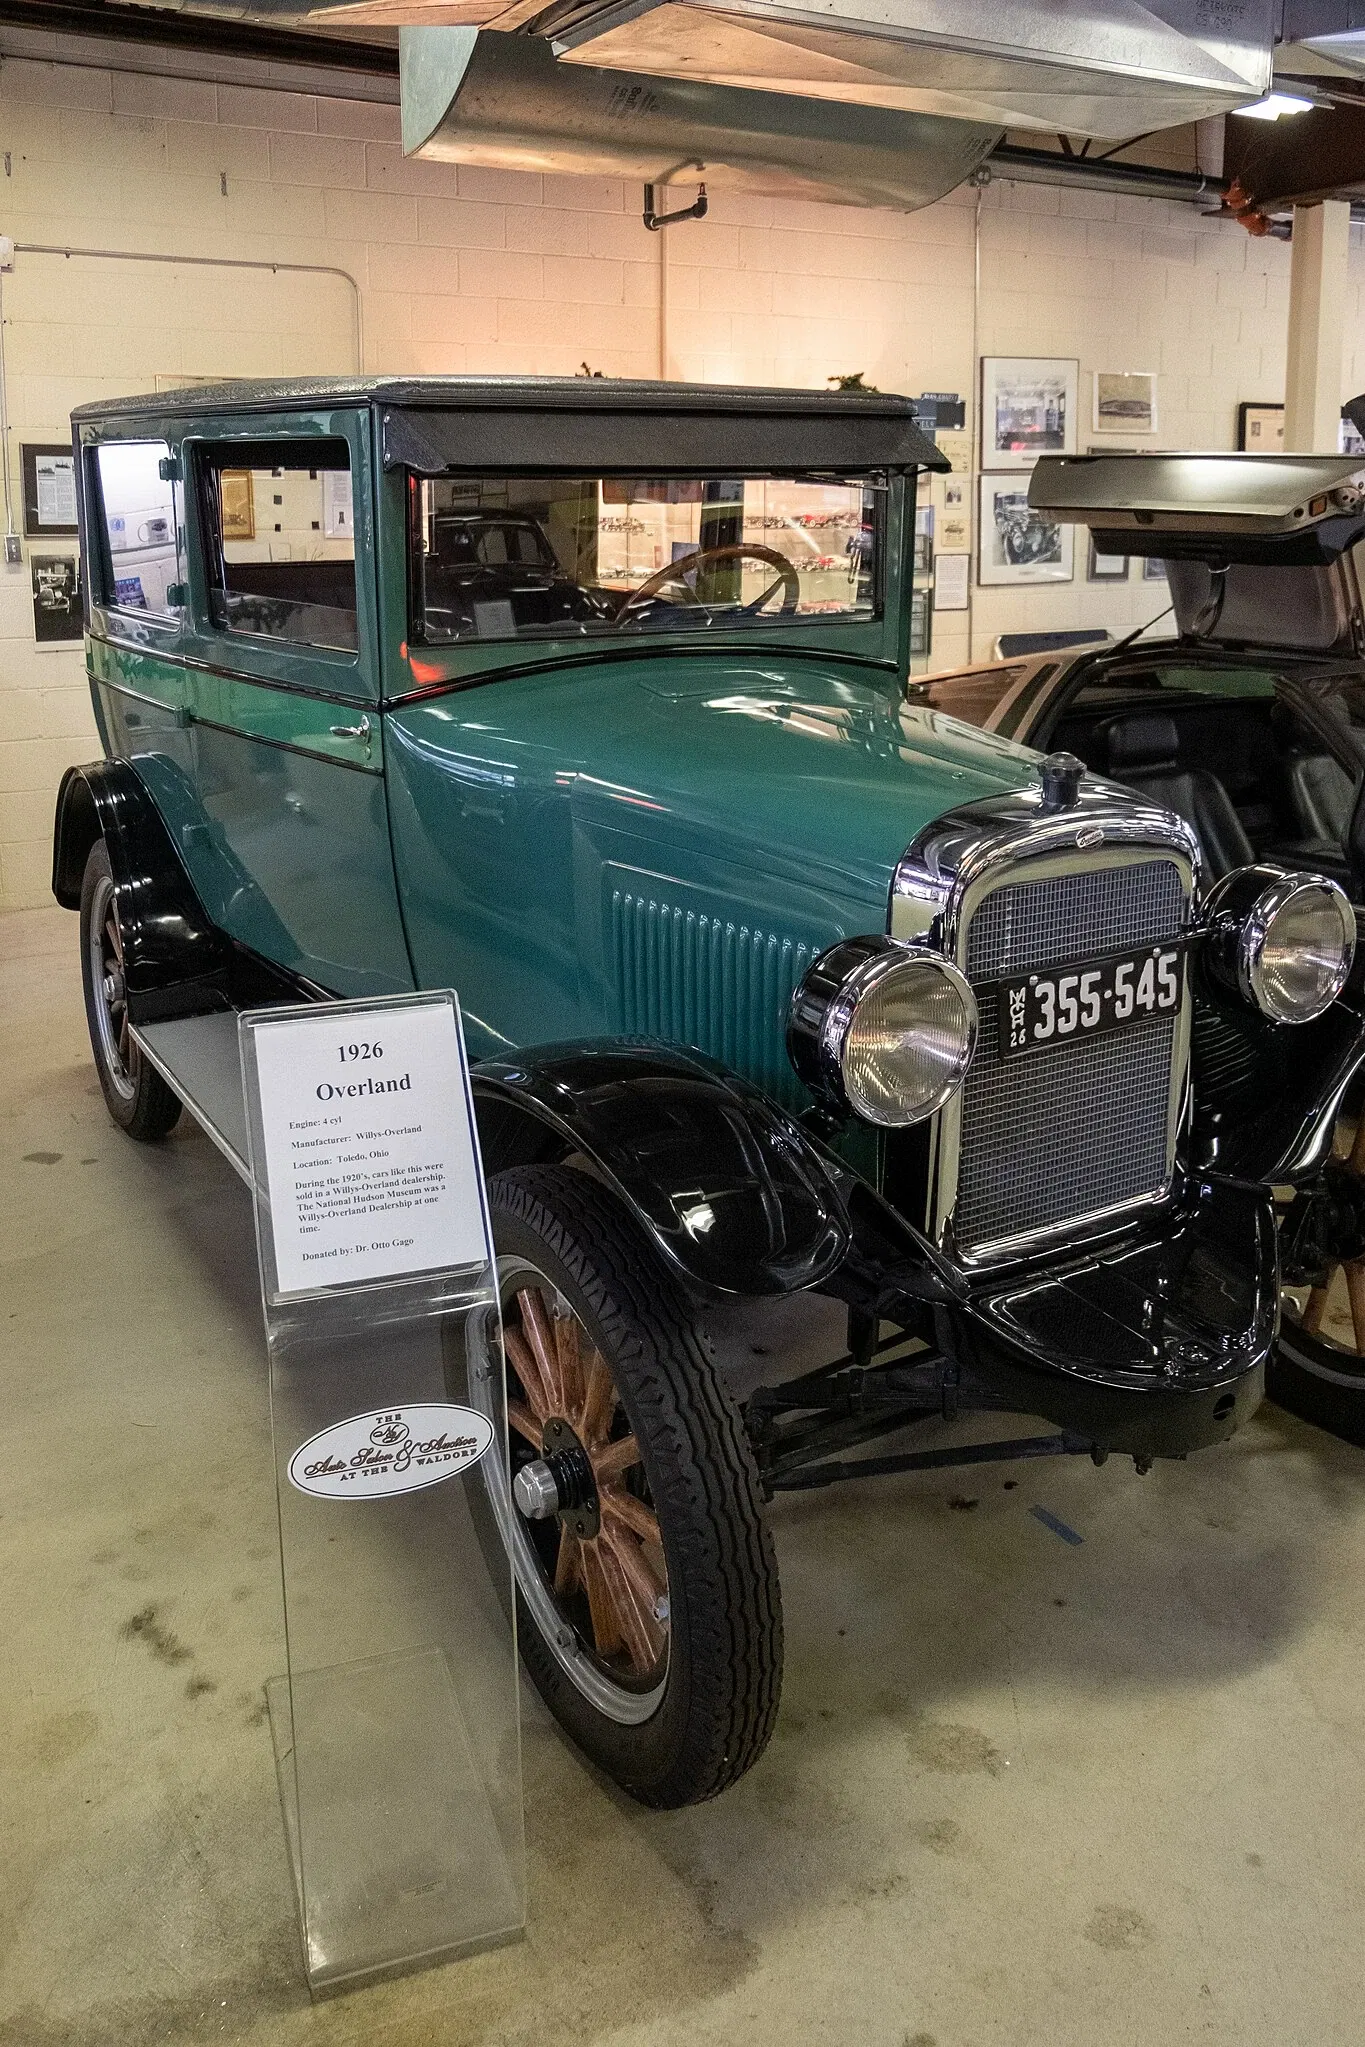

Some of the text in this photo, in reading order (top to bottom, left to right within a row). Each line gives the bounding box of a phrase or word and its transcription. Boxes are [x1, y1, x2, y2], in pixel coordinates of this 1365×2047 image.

[1034, 952, 1177, 1039] 355-545
[1010, 1029, 1026, 1047] 26
[337, 1040, 383, 1063] 1926
[316, 1073, 412, 1101] Overland
[289, 1116, 342, 1130] Engine: 4 cyl
[291, 1125, 422, 1149] Manufacturer: Willys-Overland
[293, 1150, 390, 1169] Location: Toledo, Ohio
[295, 1162, 444, 1190] During the 1920's, cars like this were
[296, 1192, 313, 1201] sold
[315, 1189, 323, 1197] in
[333, 1179, 400, 1194] Willys-Overland
[402, 1173, 446, 1186] dealership.
[297, 1203, 314, 1212] The
[316, 1197, 351, 1209] National
[353, 1193, 385, 1204] Hudson
[387, 1188, 422, 1199] Museum
[424, 1185, 439, 1193] was
[298, 1206, 367, 1222] Willys-Overland
[369, 1199, 413, 1213] Dealership
[299, 1225, 321, 1234] time.
[302, 1238, 414, 1261] Donated by: Dr. Otto Gago
[376, 1413, 402, 1424] THE
[304, 1455, 348, 1476] Auto
[350, 1447, 394, 1467] Salon
[393, 1439, 421, 1473] &
[419, 1432, 477, 1454] Auction
[339, 1448, 478, 1482] AT THE WALDORF
